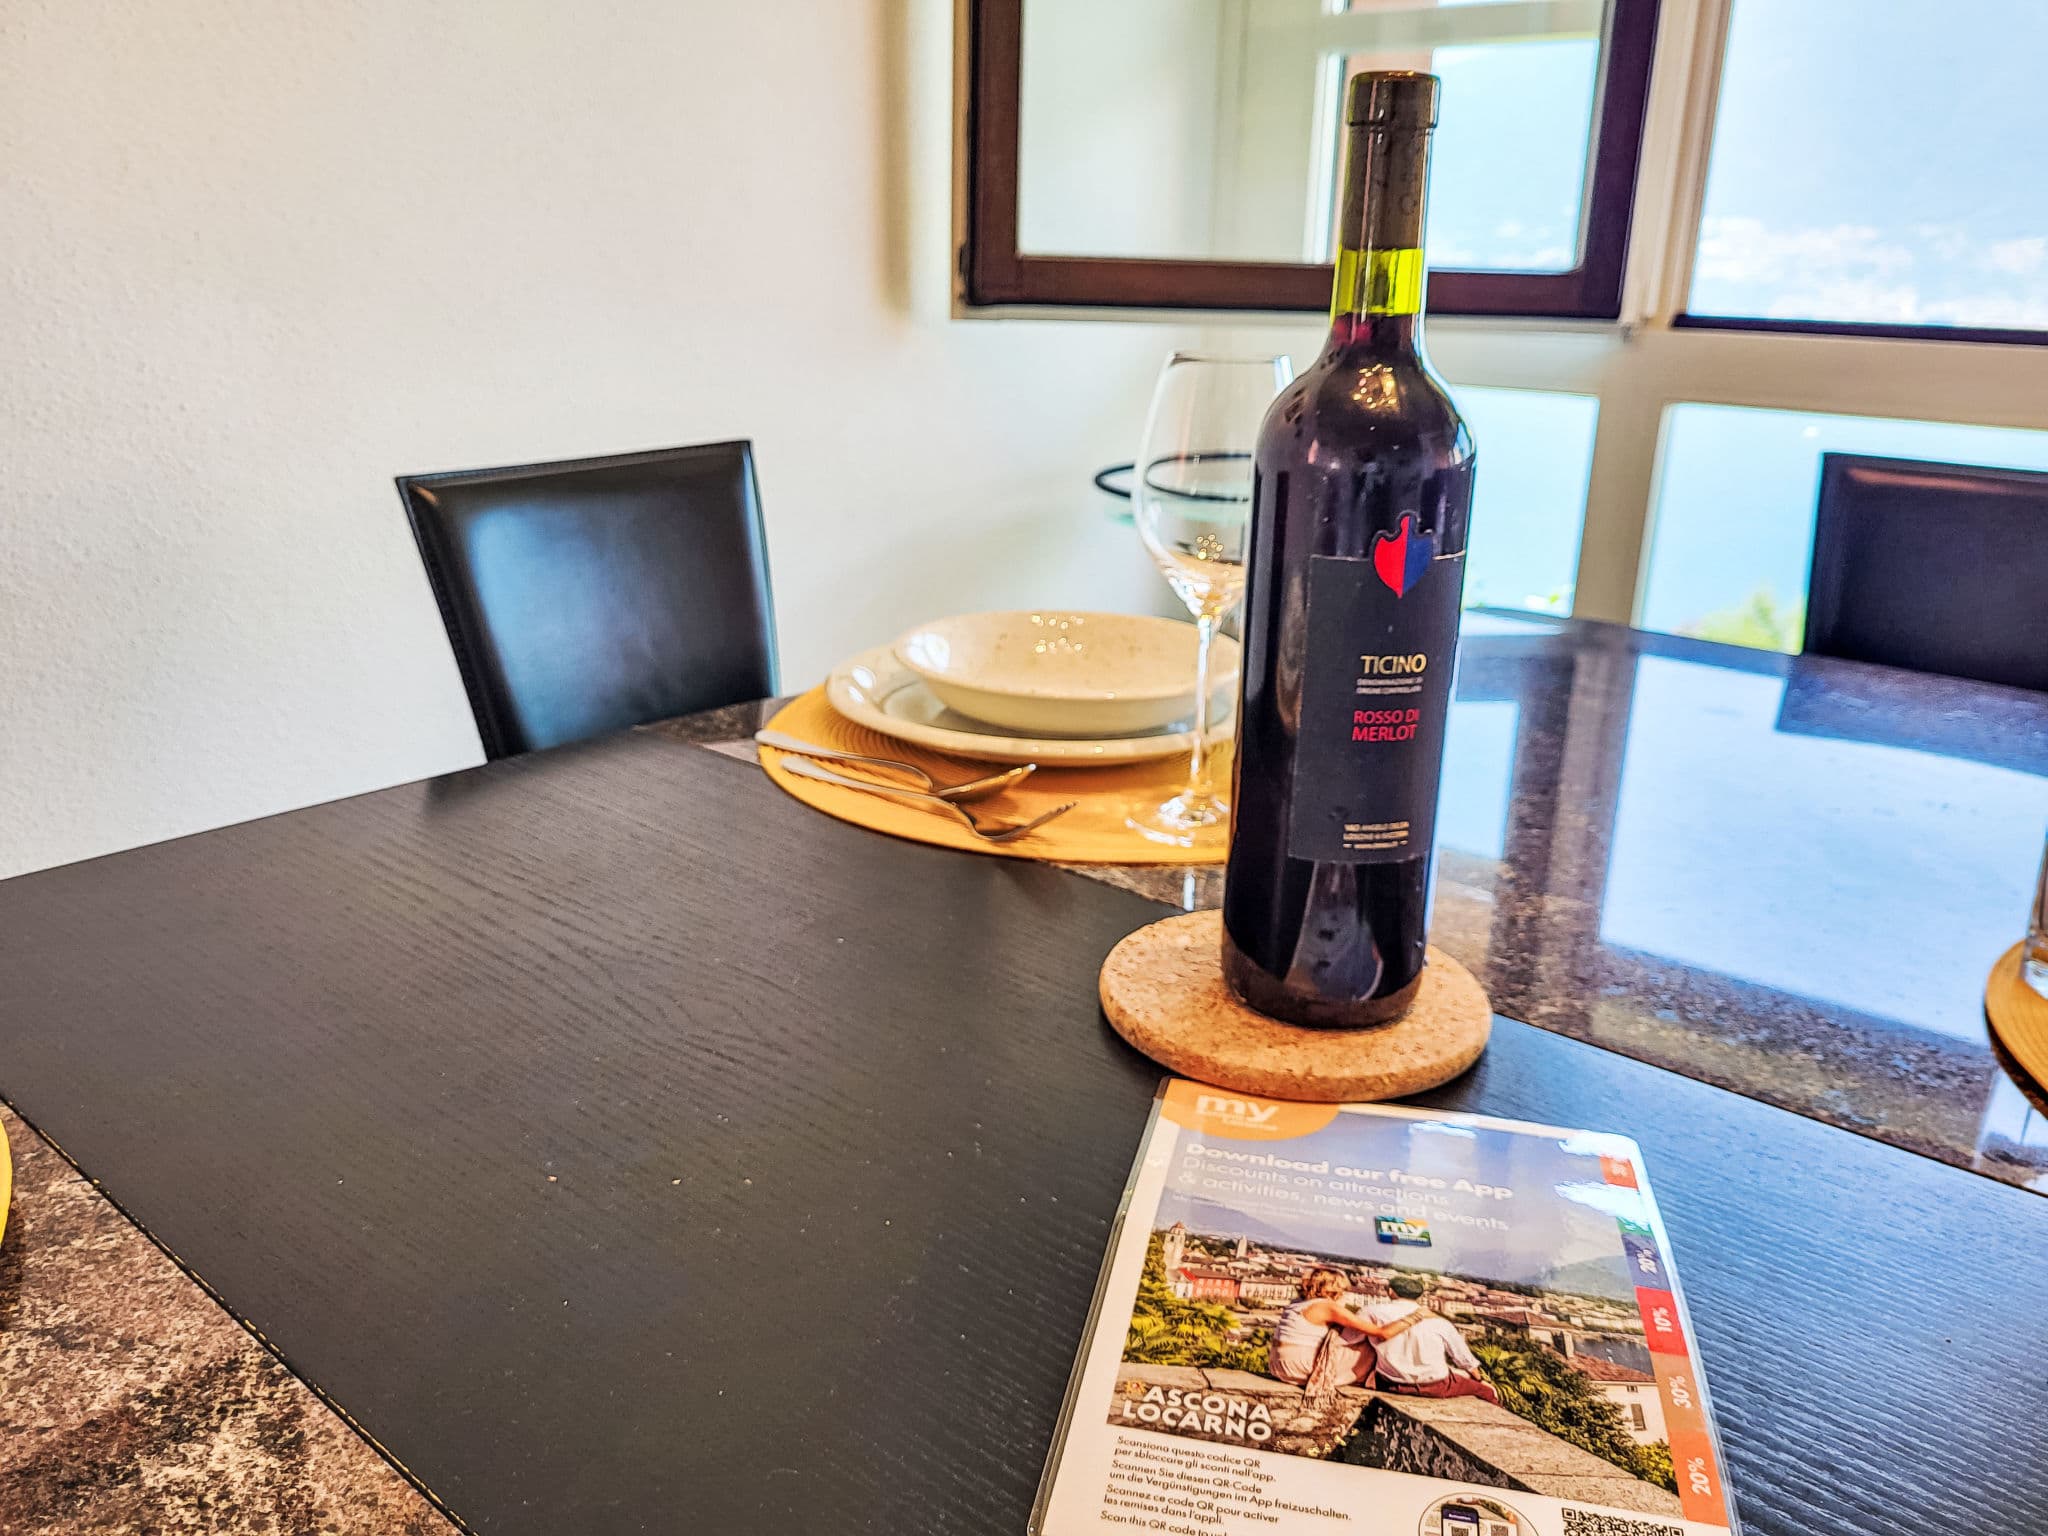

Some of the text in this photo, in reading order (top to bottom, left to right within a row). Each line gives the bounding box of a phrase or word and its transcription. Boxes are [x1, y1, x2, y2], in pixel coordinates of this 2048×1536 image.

[1360, 653, 1427, 675] TICINO
[1352, 724, 1418, 741] MERLOT
[1354, 709, 1420, 725] ROSSO DI
[1196, 1094, 1279, 1122] my
[1183, 1155, 1289, 1185] Discounts
[1293, 1175, 1322, 1189] on
[1185, 1143, 1514, 1200] Download our free App
[1314, 1192, 1376, 1212] news
[1380, 1201, 1427, 1218] and
[1380, 1219, 1426, 1237] my
[1653, 1306, 1673, 1333] 10%
[1142, 1384, 1273, 1423] ASCONA
[1672, 1374, 1692, 1409] 30%
[1122, 1399, 1273, 1441] LOCARNO
[1114, 1447, 1131, 1456] per
[1134, 1449, 1183, 1466] sbloccare
[1185, 1458, 1198, 1469] gli
[1200, 1462, 1230, 1474] sconti
[1118, 1435, 1261, 1469] Scansiona questo codice QR
[1112, 1459, 1262, 1494] Scannen Sie diesen QR-Code
[1687, 1455, 1712, 1497] 20%
[1104, 1493, 1118, 1506] les
[1120, 1500, 1159, 1513] remises
[1161, 1505, 1187, 1518] dans
[1106, 1483, 1279, 1524] Scannez ce code QR pour activer
[1109, 1471, 1352, 1521] um die Vergünstigungen im App freizuschalten.
[1101, 1510, 1127, 1523] Scan
[1129, 1515, 1146, 1528] this
[1149, 1519, 1167, 1531] QR
[1169, 1525, 1196, 1536] code
